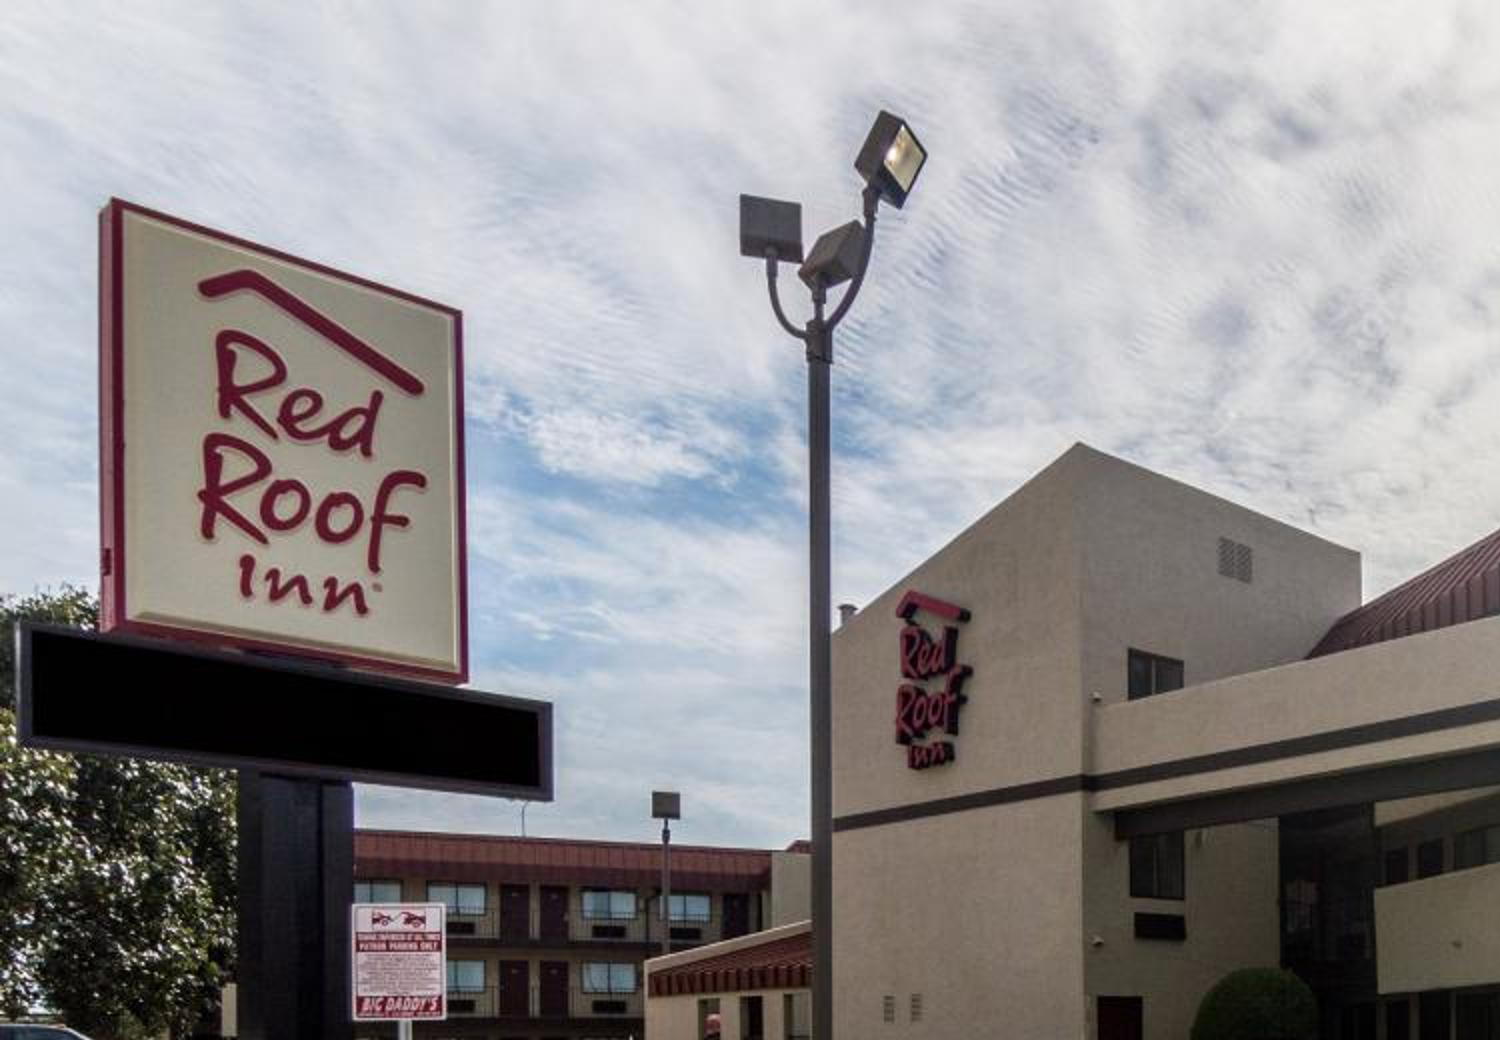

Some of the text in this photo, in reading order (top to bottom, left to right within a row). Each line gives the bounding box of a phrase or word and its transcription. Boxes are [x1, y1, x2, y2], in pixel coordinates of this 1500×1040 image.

[215, 329, 383, 458] Red
[197, 432, 427, 574] Roof
[901, 626, 958, 680] Red
[896, 663, 974, 745] Roof
[361, 996, 439, 1012] BIG DADDY'S
